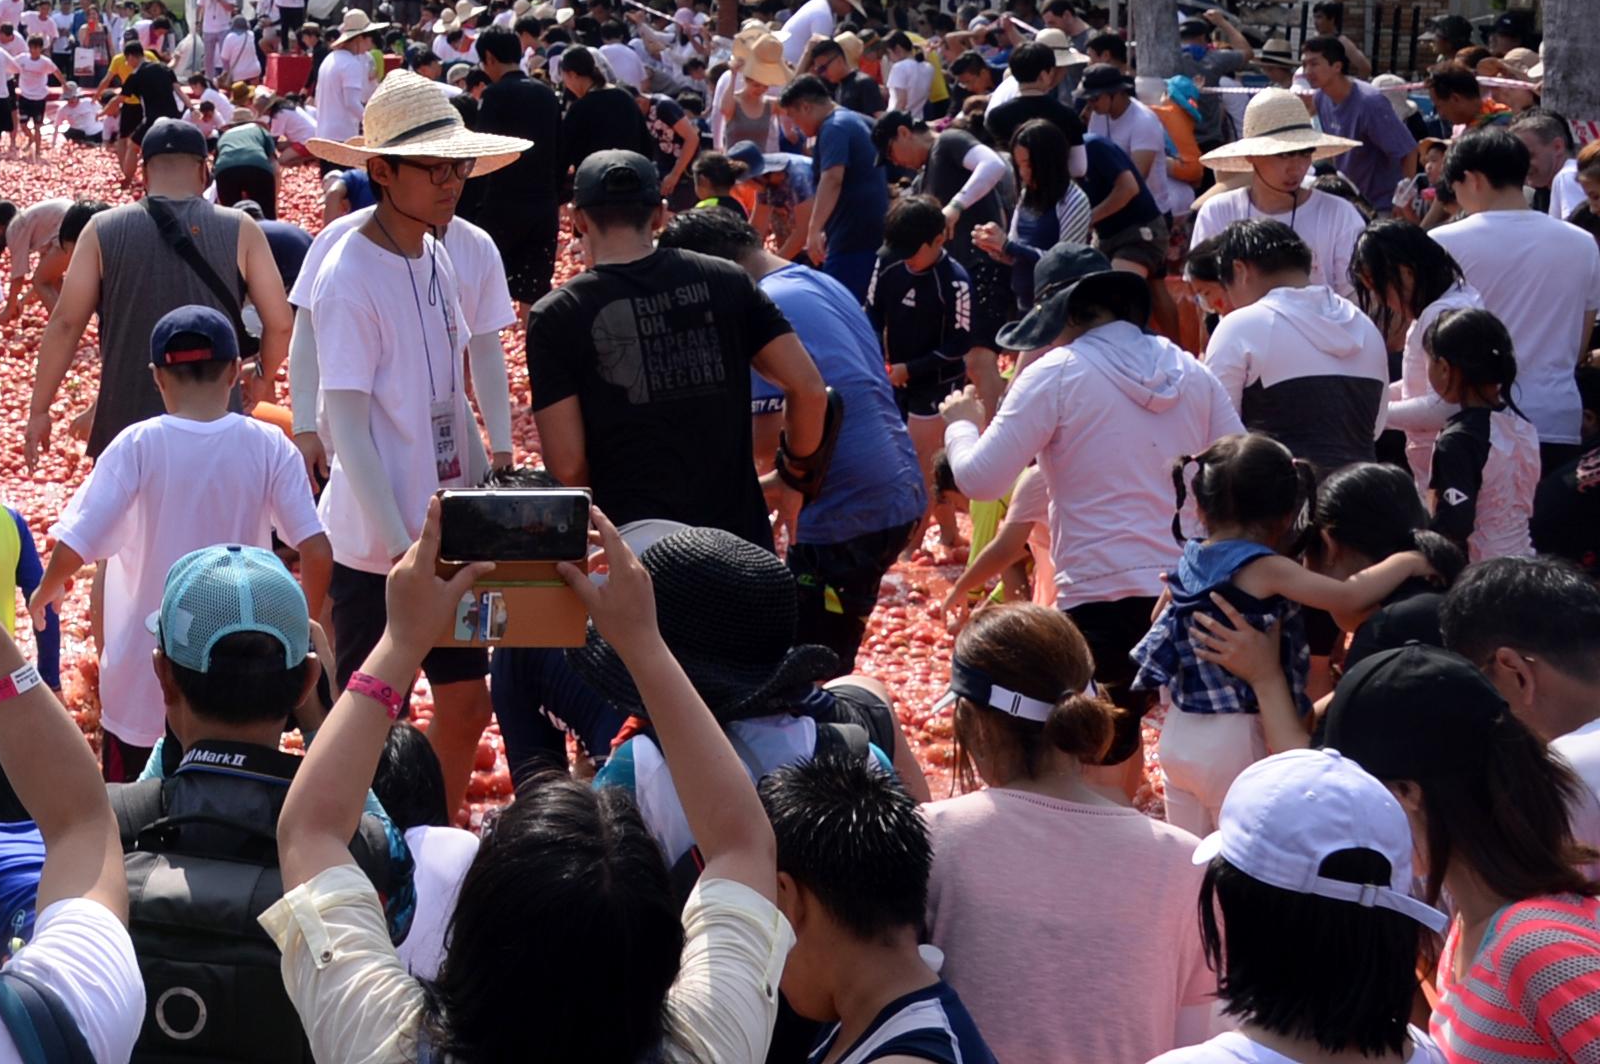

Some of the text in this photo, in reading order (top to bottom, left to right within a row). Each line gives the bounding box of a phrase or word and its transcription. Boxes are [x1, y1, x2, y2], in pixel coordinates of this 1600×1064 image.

[634, 281, 710, 315] EUN-SUN
[647, 345, 723, 373] CLIMBING
[651, 363, 725, 390] RECORD
